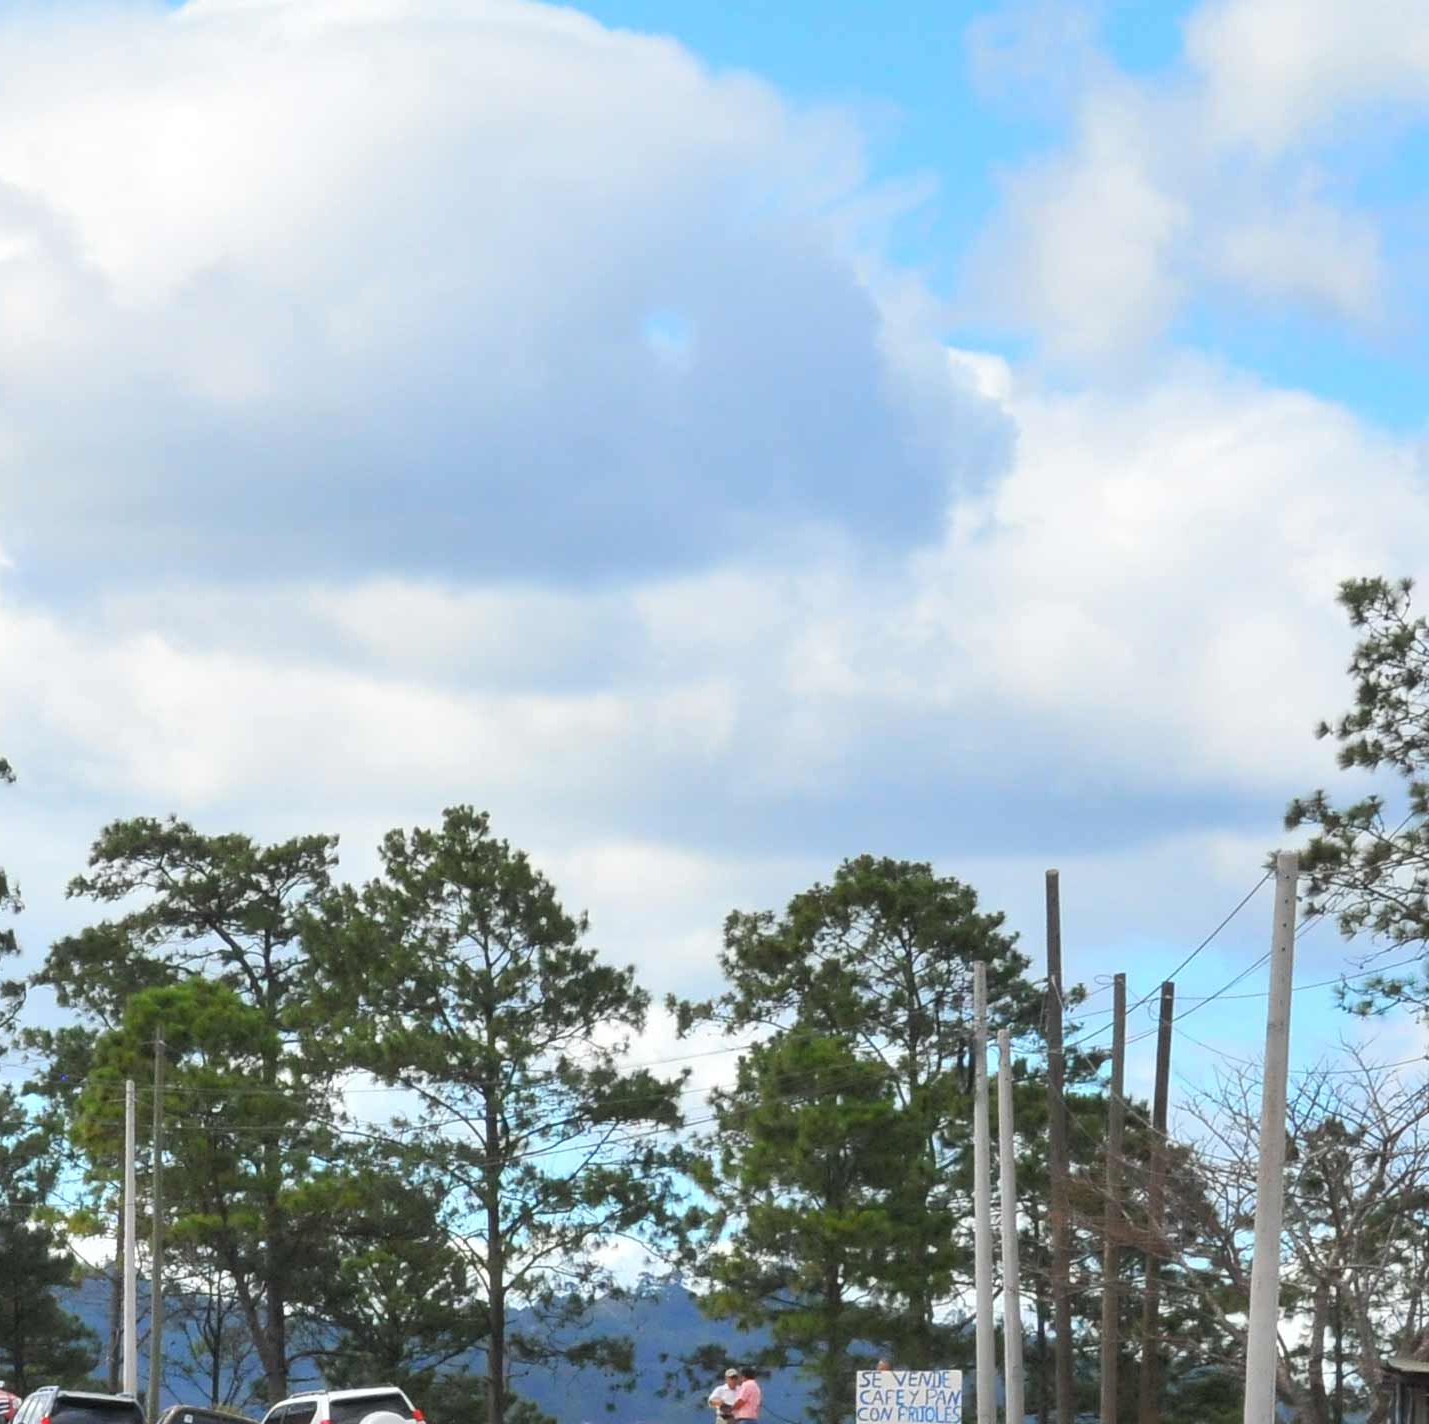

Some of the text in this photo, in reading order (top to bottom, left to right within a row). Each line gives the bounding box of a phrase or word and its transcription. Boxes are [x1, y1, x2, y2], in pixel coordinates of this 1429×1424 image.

[859, 1371, 951, 1388] SE VENDE
[859, 1390, 962, 1405] CAFE Y PAN
[857, 1407, 893, 1422] CON
